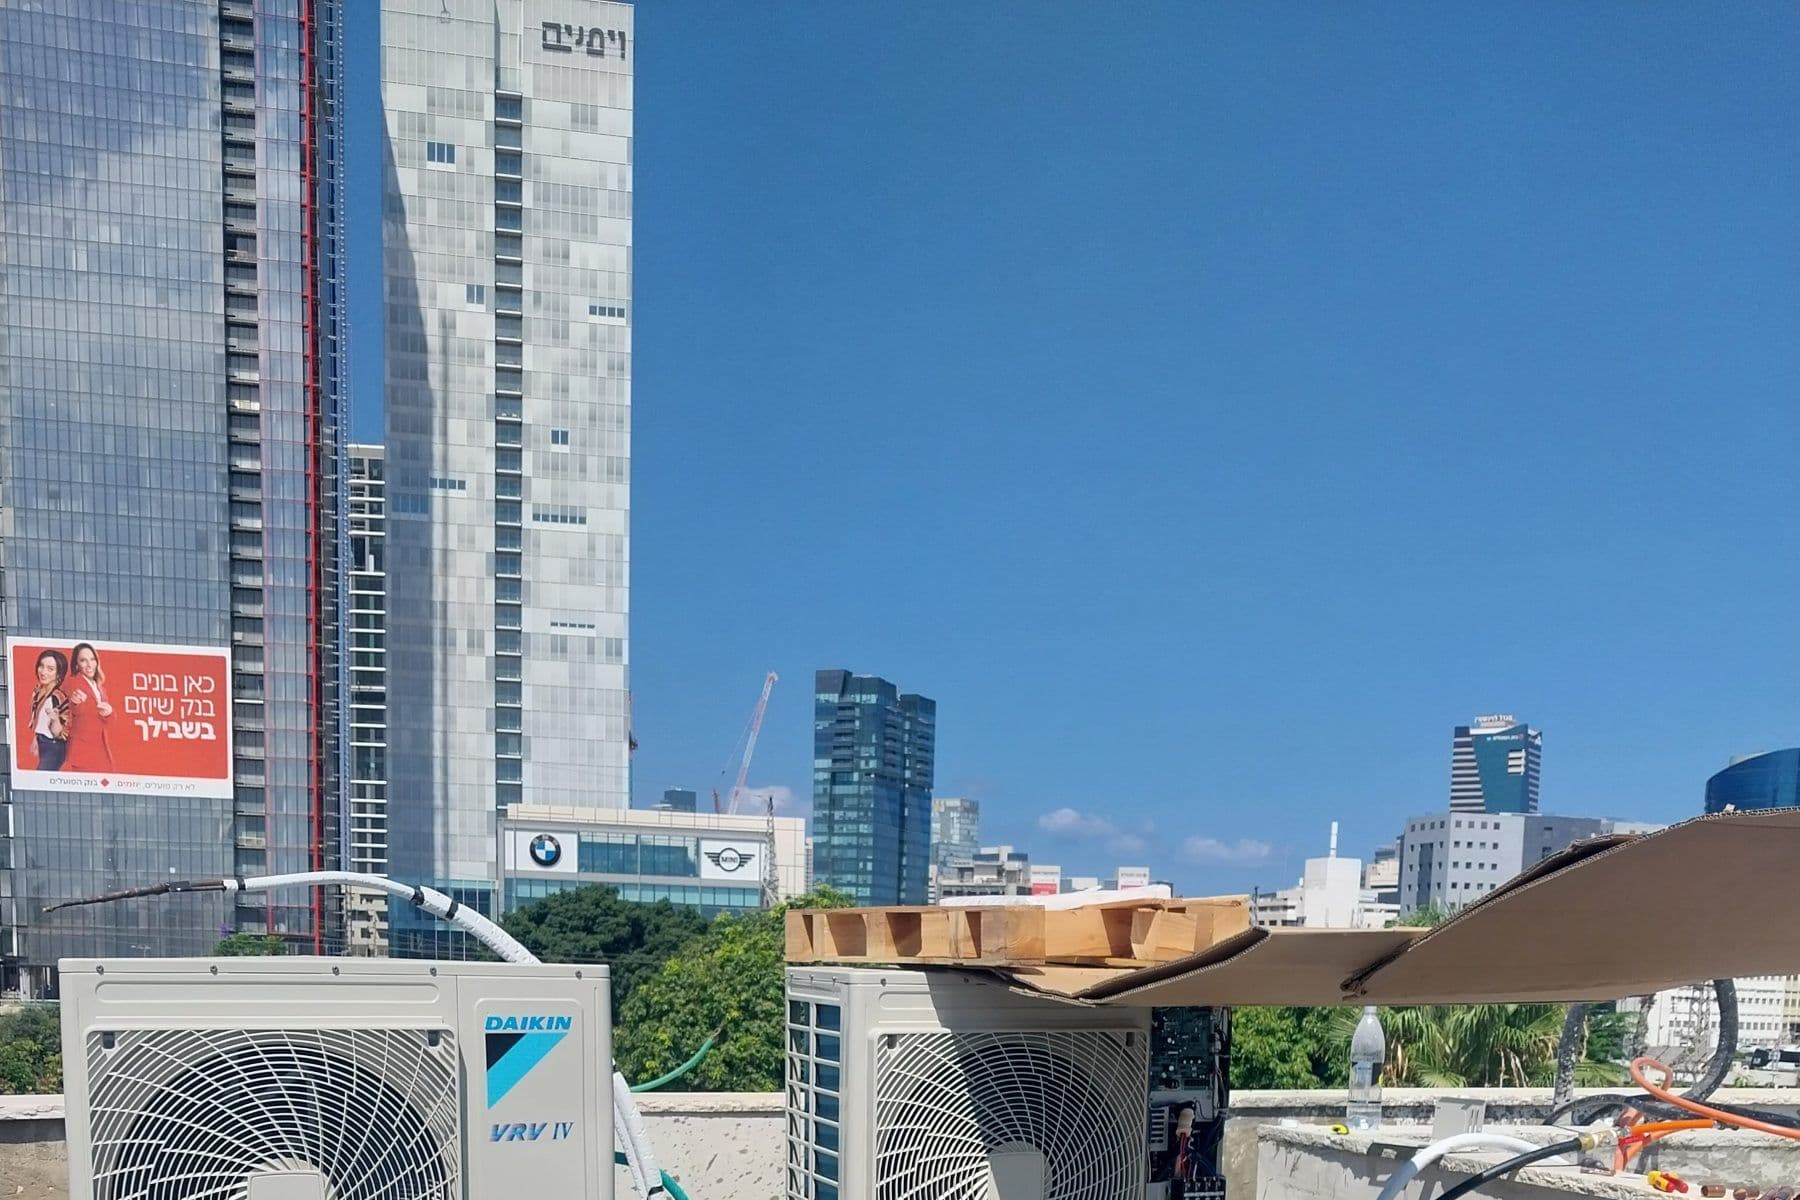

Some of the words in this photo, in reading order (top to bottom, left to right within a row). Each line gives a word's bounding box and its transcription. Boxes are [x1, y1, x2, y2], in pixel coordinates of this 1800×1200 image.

[133, 673, 178, 692] בונים
[184, 675, 215, 696] כאן
[124, 695, 174, 715] שיוזם
[180, 698, 216, 719] בנק
[134, 716, 217, 741] בשבילך
[485, 1016, 572, 1030] DAIKIN
[489, 1122, 548, 1142] VRV
[553, 1122, 575, 1139] IV
